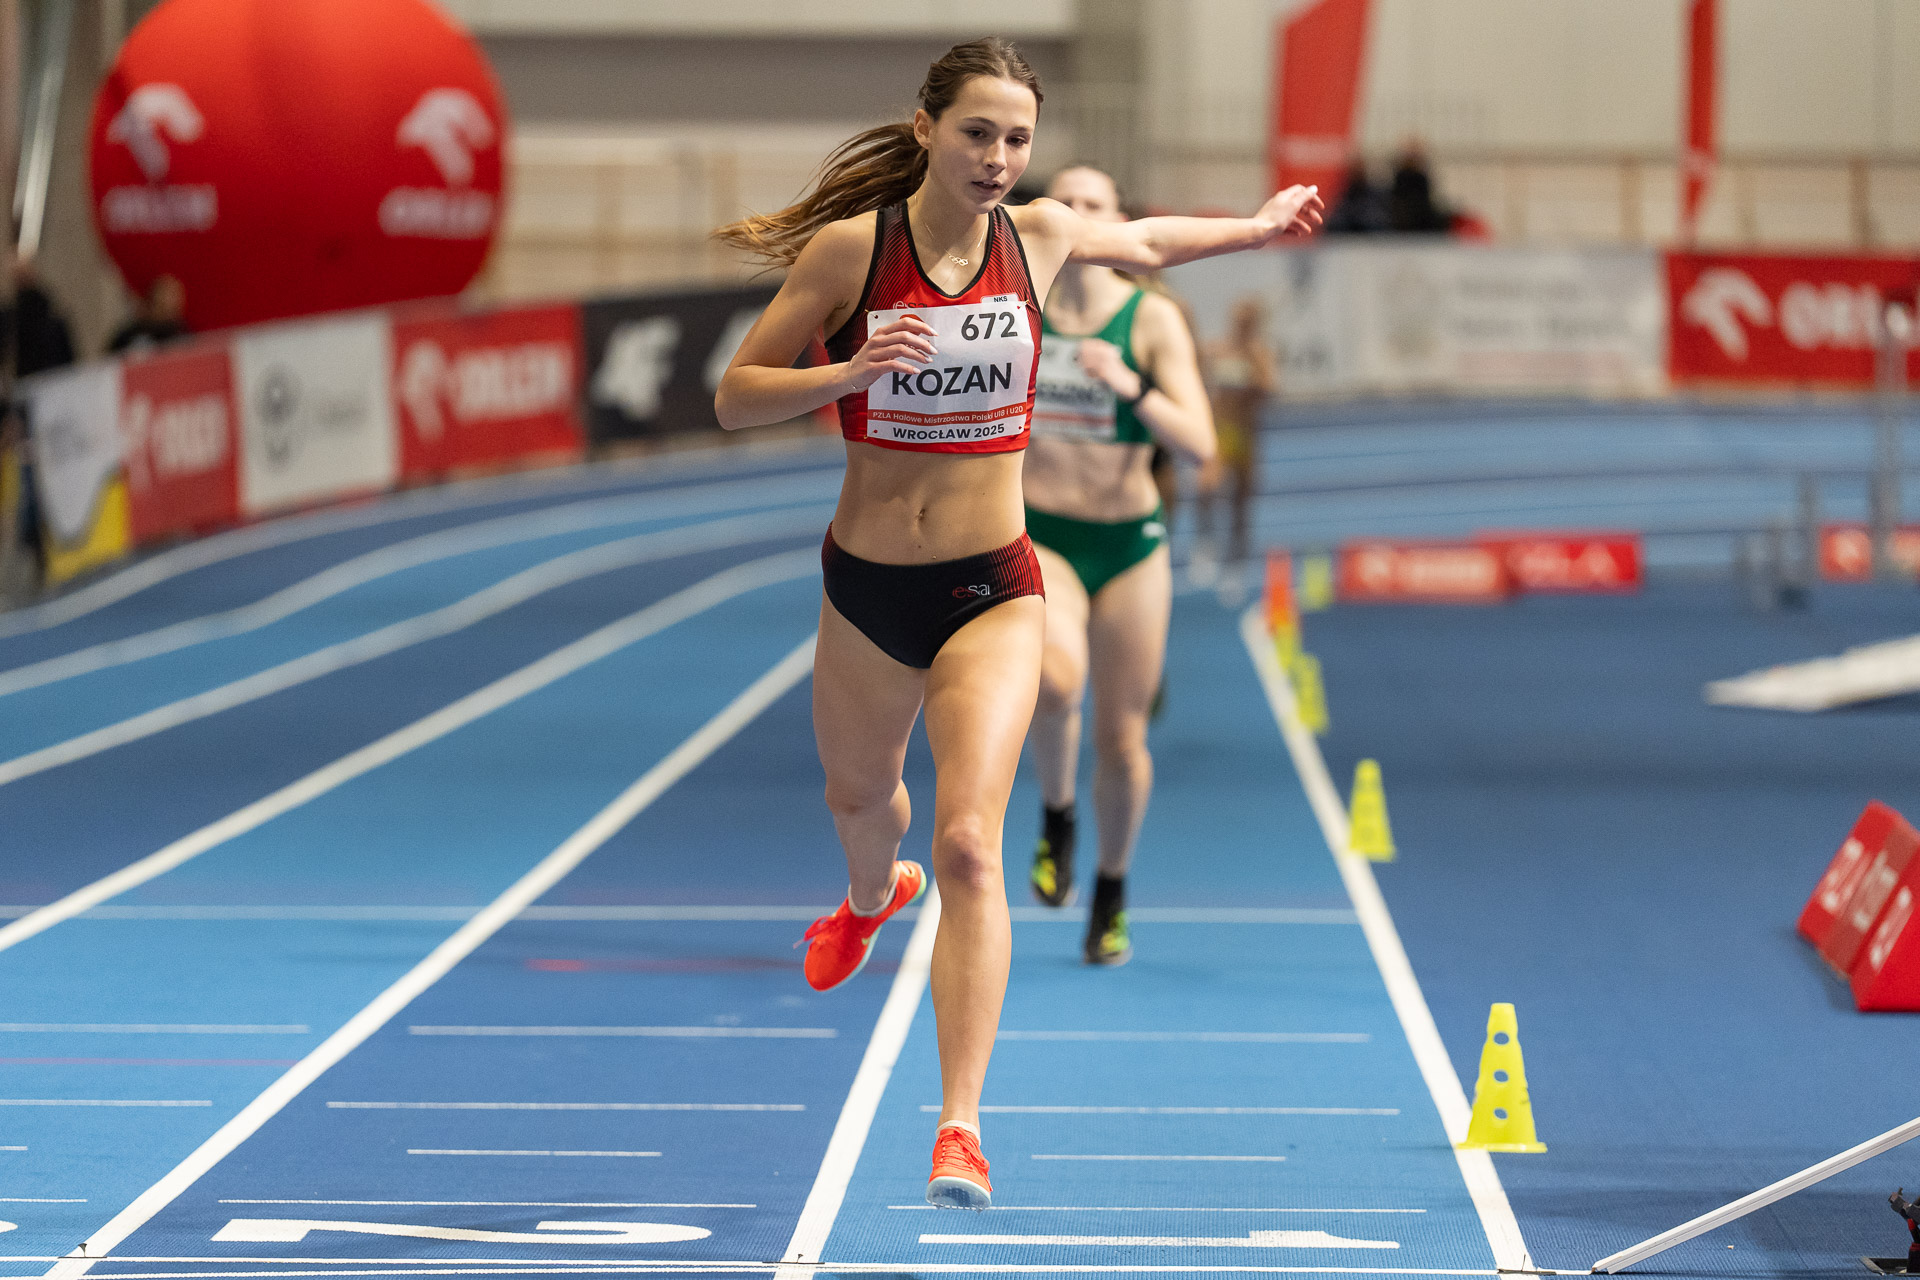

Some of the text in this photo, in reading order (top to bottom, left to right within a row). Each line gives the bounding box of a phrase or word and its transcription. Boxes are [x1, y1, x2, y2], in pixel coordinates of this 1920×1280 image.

[993, 295, 1008, 303] NKS
[961, 311, 1018, 341] 672
[892, 362, 1012, 396] KOZAN
[872, 411, 892, 420] PZLA
[893, 413, 923, 423] Halowe
[924, 414, 970, 424] Mistrzostwa
[971, 411, 993, 421] Polski
[994, 409, 1005, 418] U18
[1009, 405, 1024, 414] U20
[893, 423, 1005, 440] WROCŁAW 2025
[212, 1218, 712, 1243] 2
[919, 1230, 1399, 1249] 1
